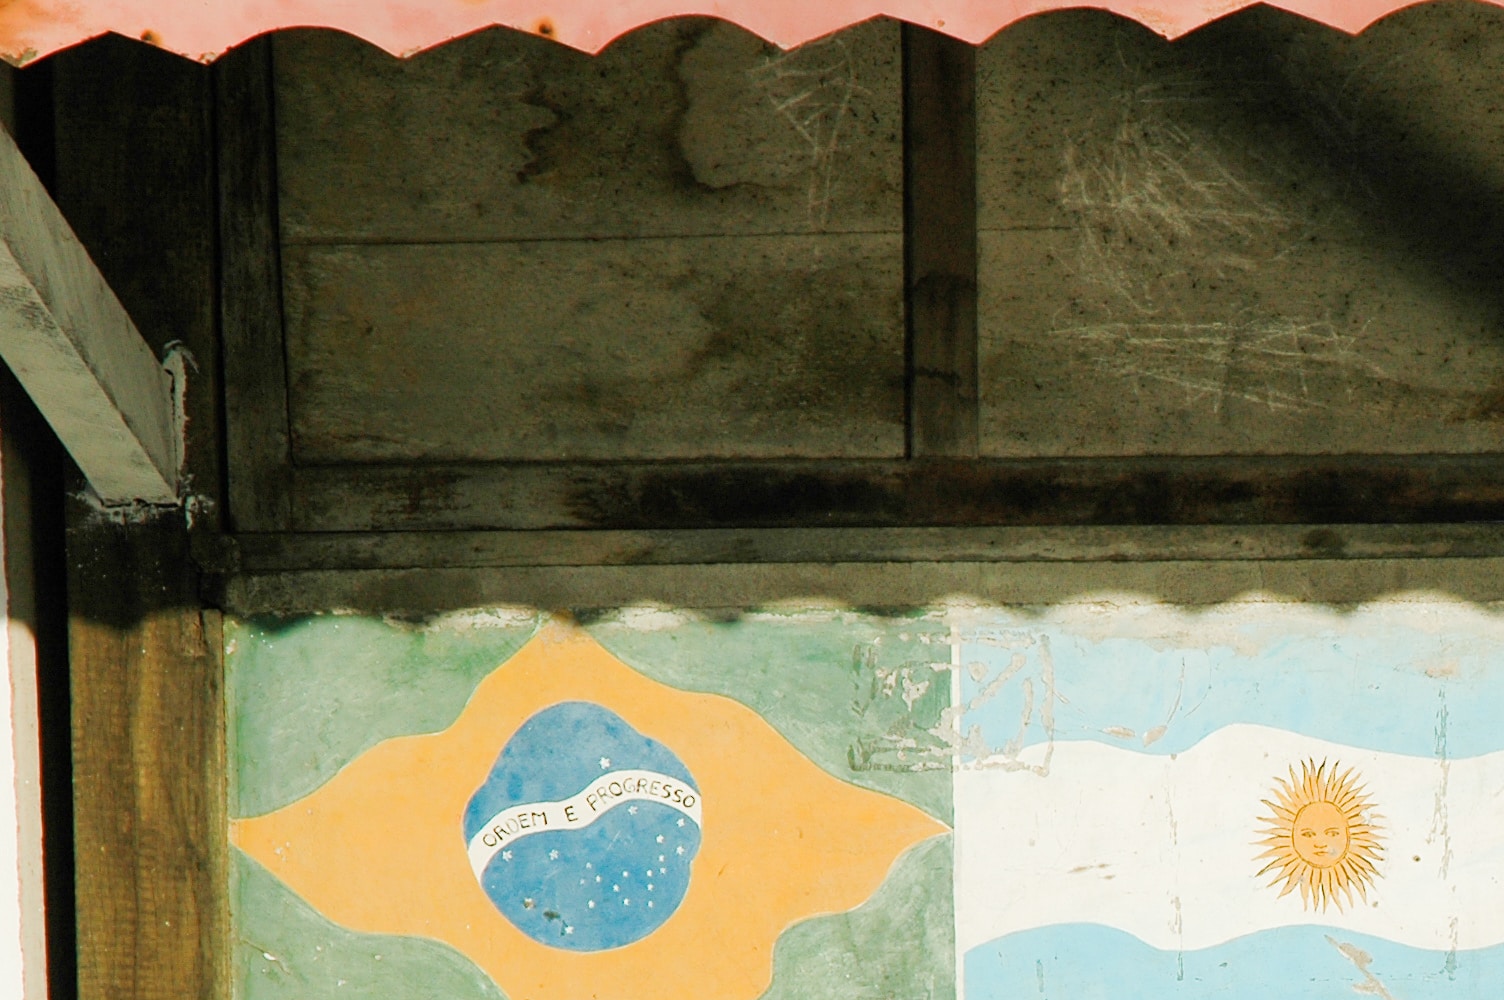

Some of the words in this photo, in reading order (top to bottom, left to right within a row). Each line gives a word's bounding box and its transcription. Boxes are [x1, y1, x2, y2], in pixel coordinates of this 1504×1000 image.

[482, 810, 548, 848] ORDEM
[564, 805, 578, 823] E
[586, 777, 696, 812] PROGRESSO
